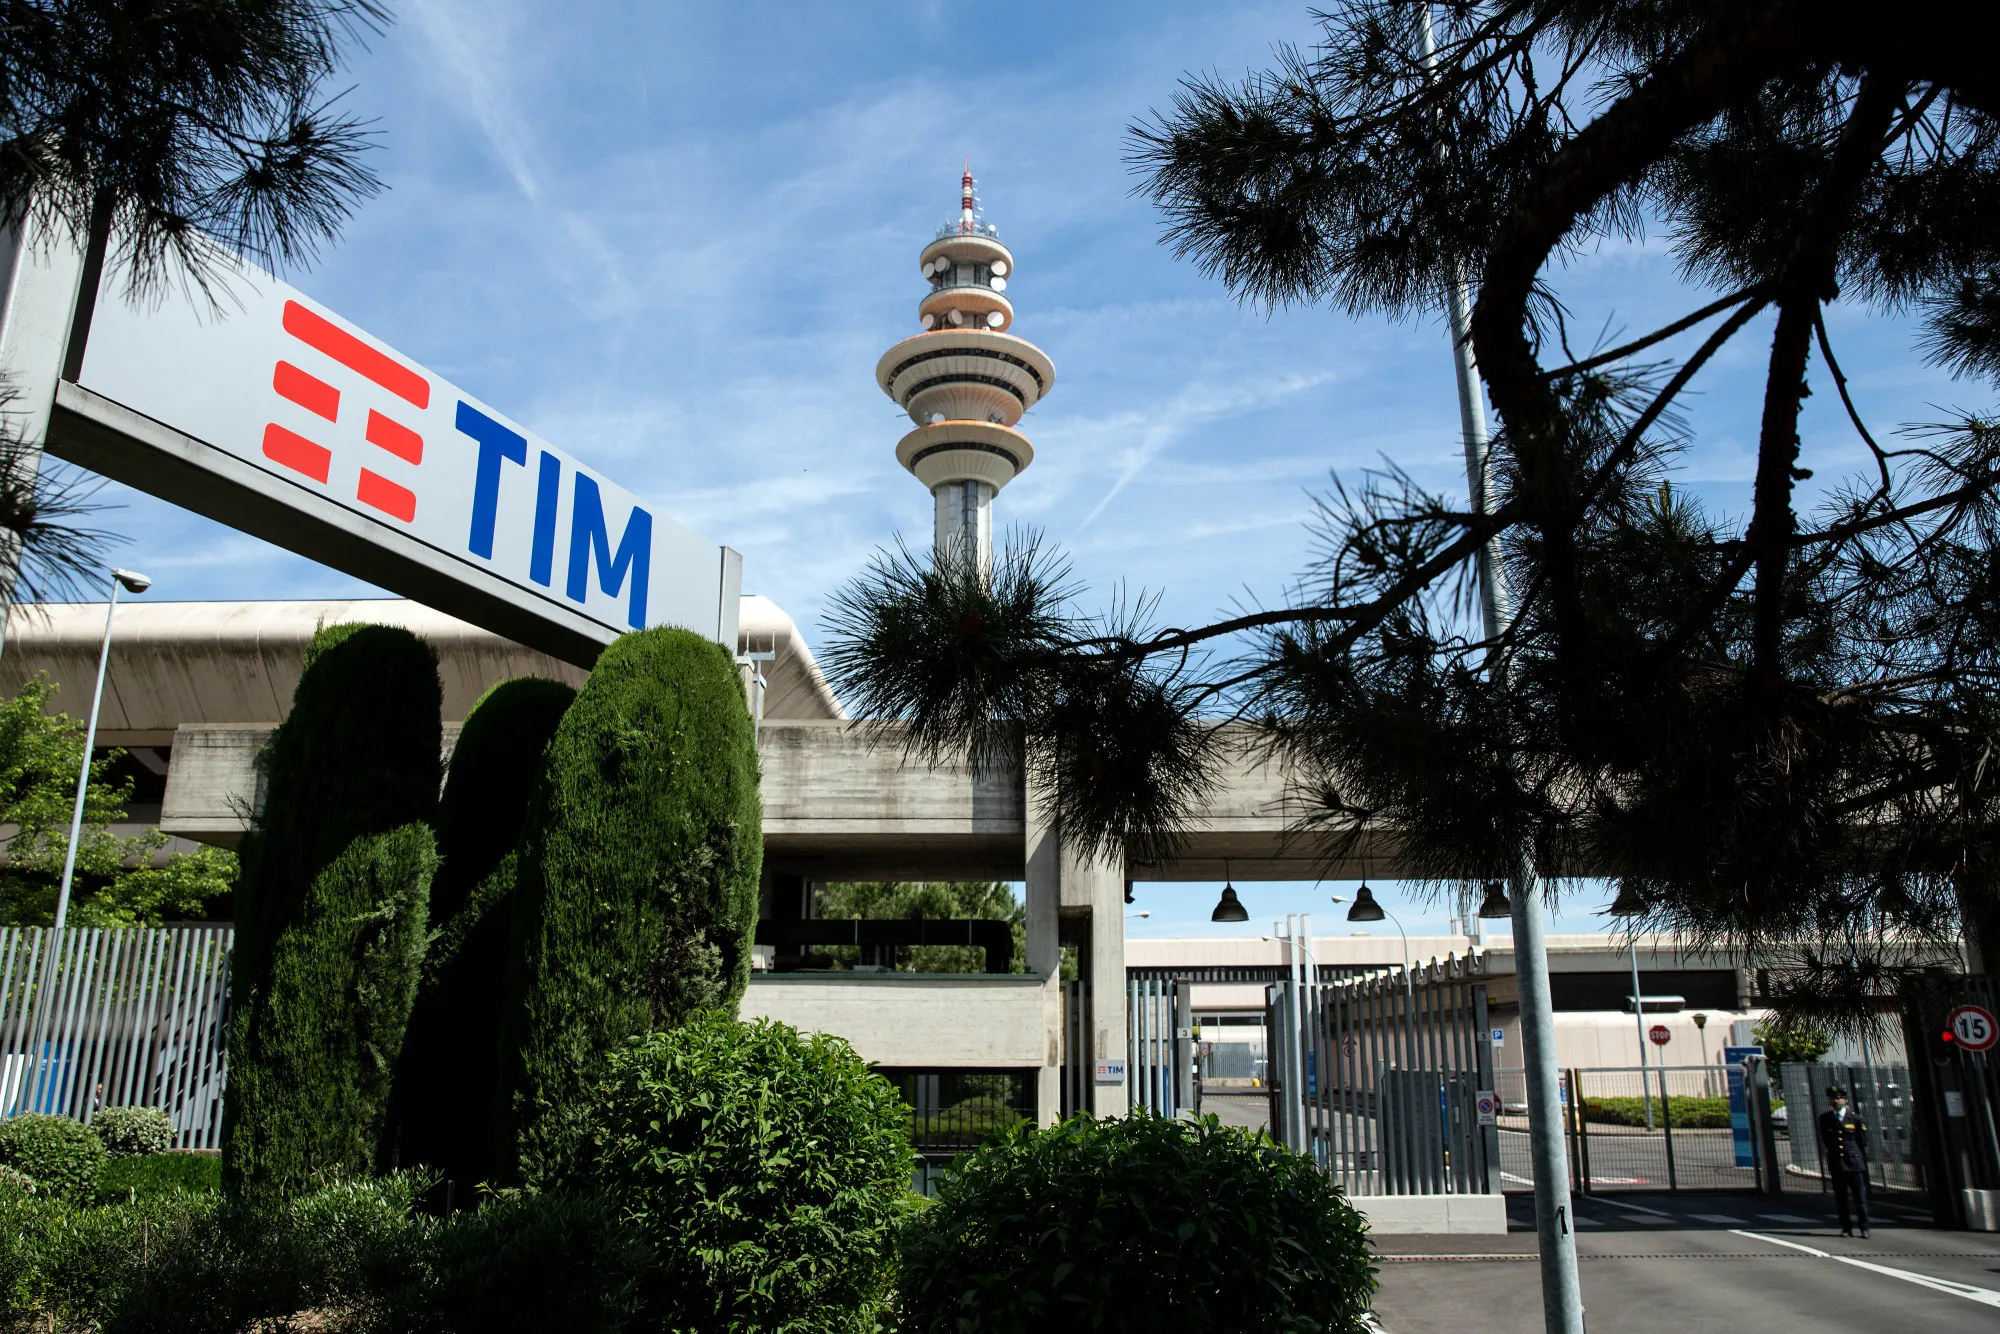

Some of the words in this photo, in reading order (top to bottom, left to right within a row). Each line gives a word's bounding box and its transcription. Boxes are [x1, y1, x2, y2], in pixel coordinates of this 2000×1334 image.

[455, 399, 652, 631] TIM
[1651, 1031, 1669, 1040] STOP
[1961, 1018, 1985, 1039] 15
